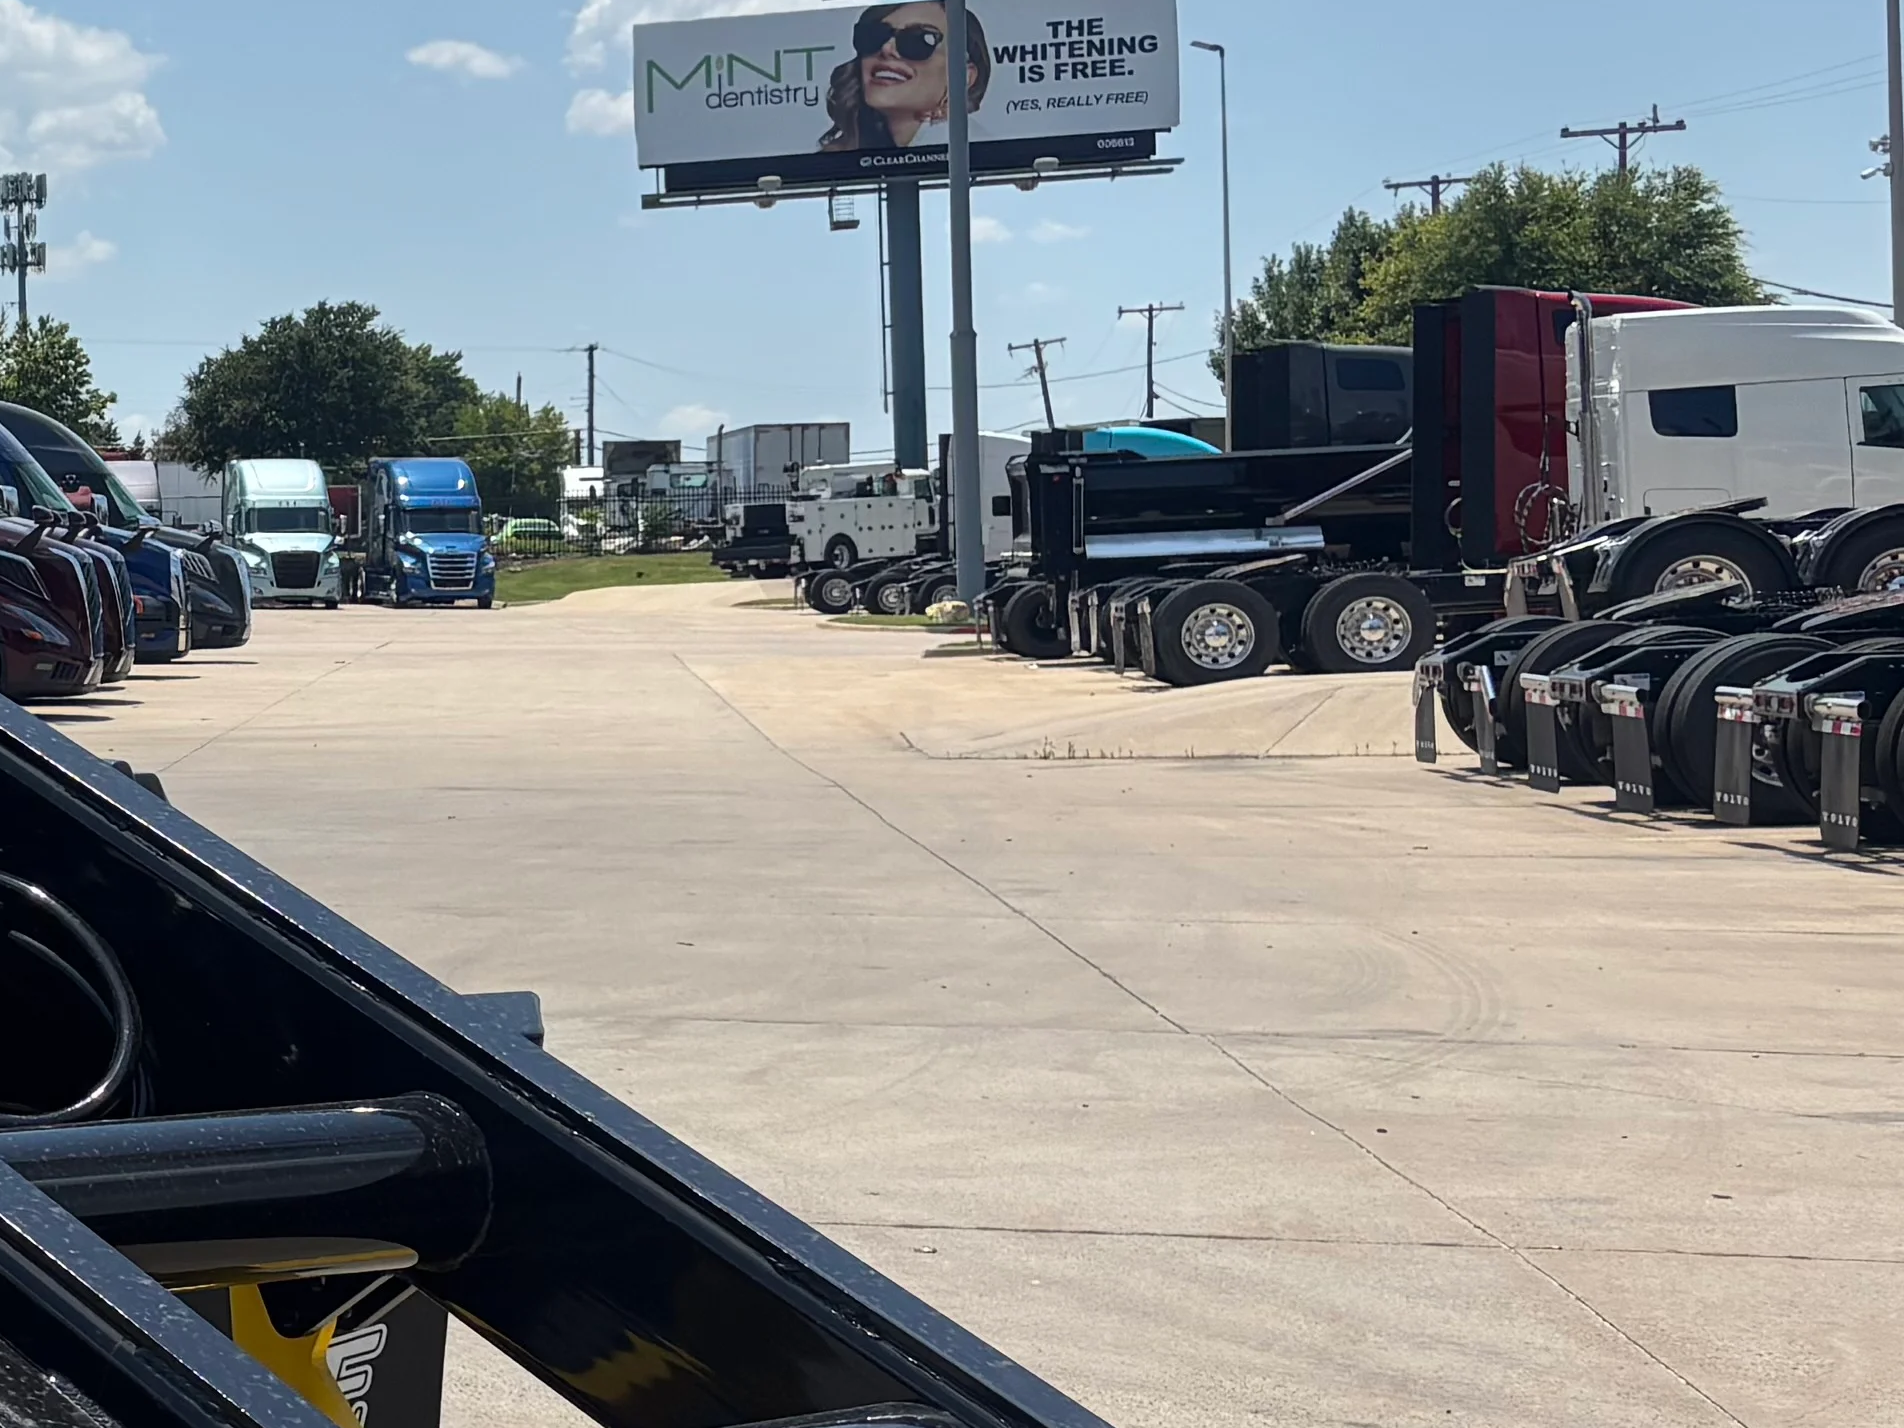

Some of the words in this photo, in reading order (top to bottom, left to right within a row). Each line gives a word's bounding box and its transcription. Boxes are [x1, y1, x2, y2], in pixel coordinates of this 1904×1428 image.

[1045, 17, 1104, 39] THE
[993, 34, 1159, 64] WHITENING
[1018, 64, 1045, 83] IS
[1054, 58, 1135, 81] FREE.
[705, 73, 820, 110] dentistry
[1006, 98, 1042, 114] (YES,
[1046, 93, 1104, 109] REALLY
[1105, 90, 1149, 105] FREE)
[1715, 791, 1749, 806] VOLVO
[1822, 811, 1859, 827] VOLVO
